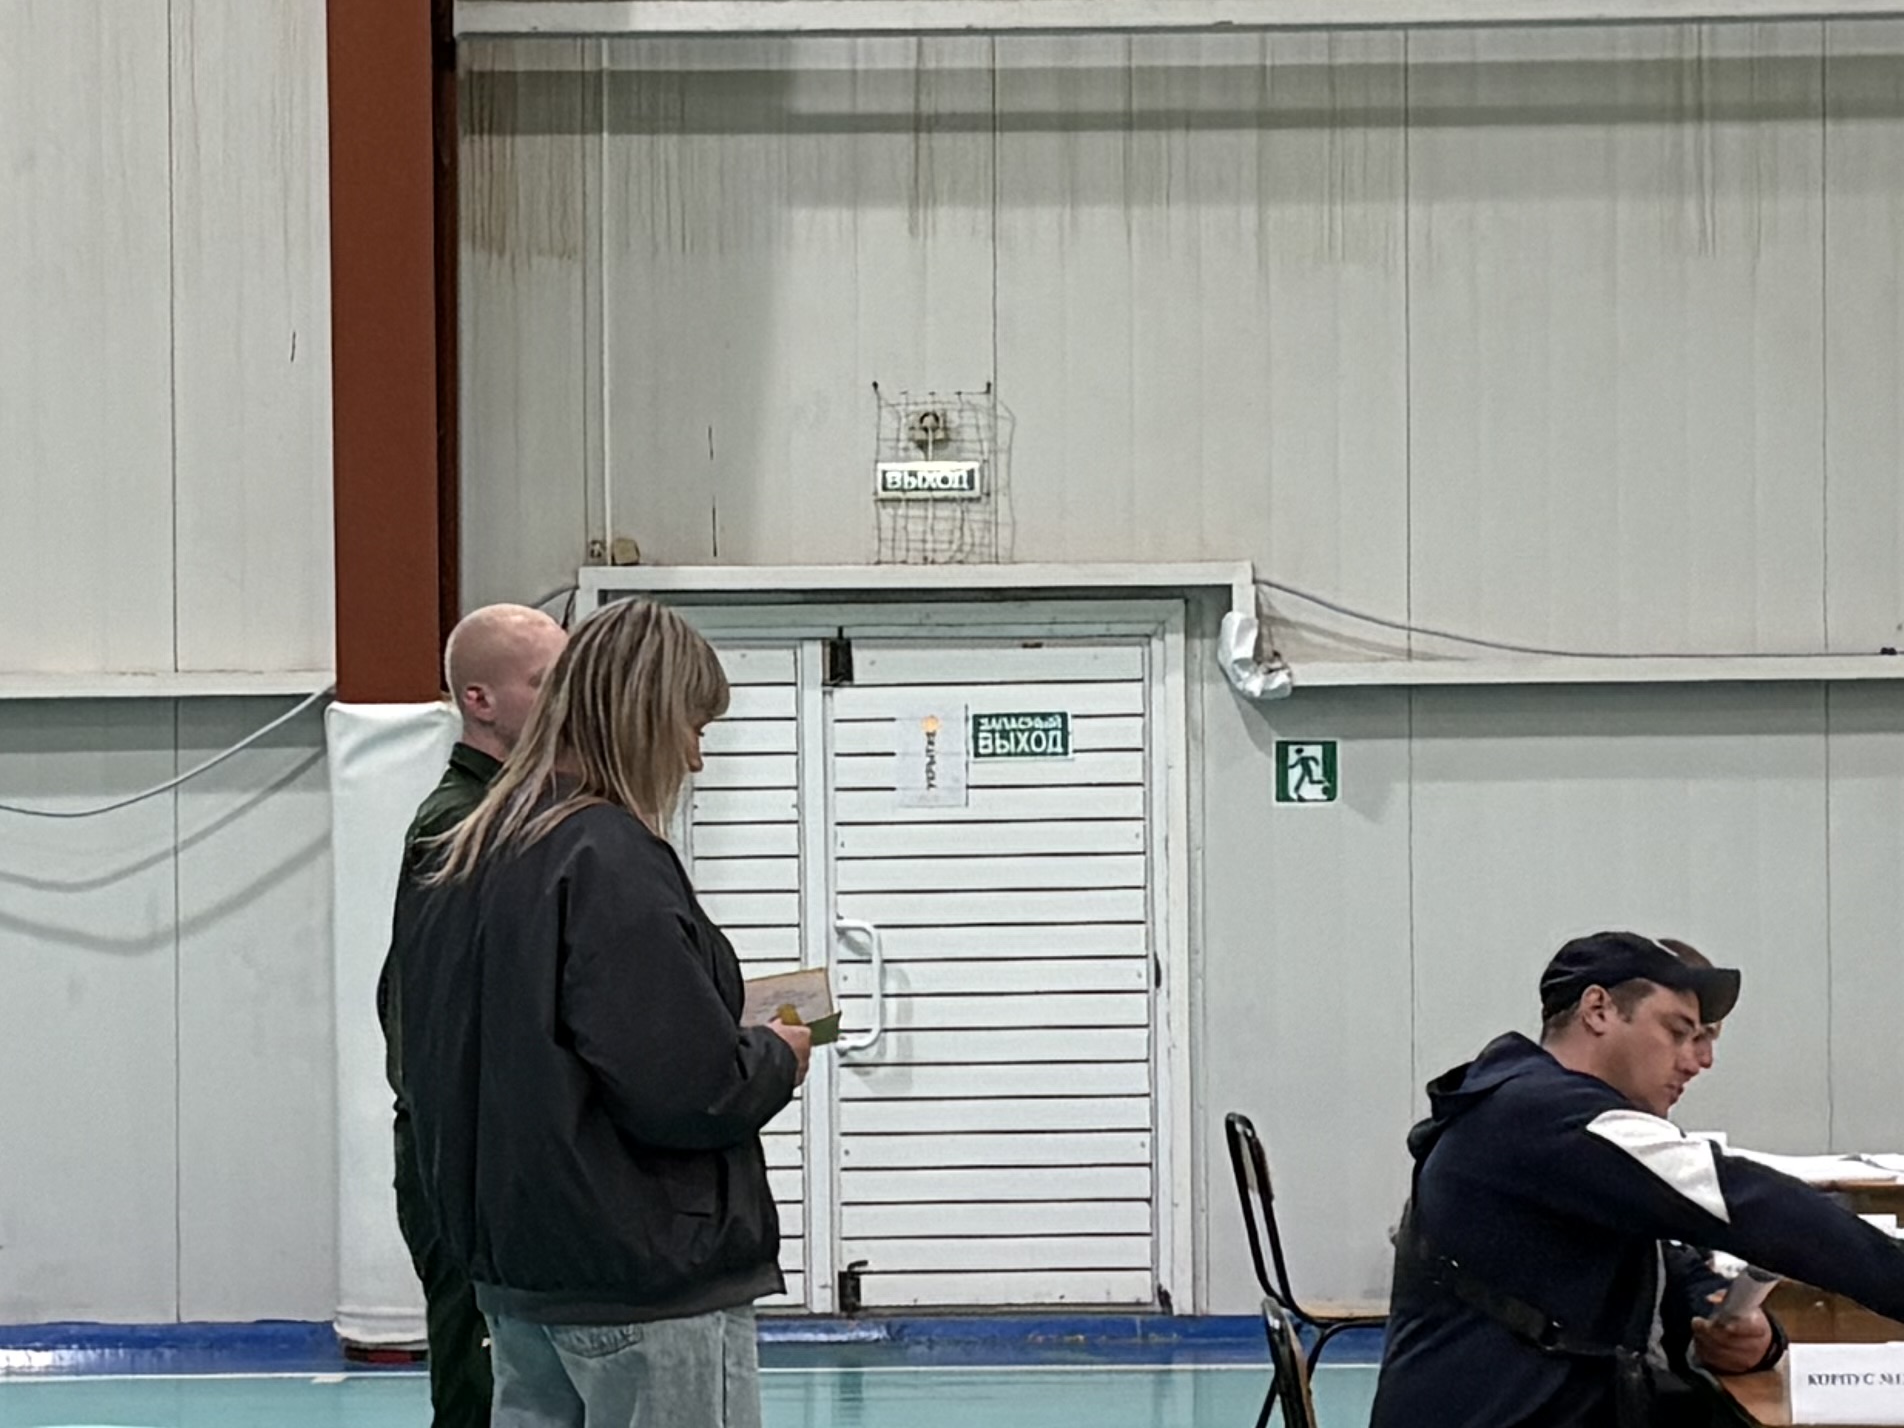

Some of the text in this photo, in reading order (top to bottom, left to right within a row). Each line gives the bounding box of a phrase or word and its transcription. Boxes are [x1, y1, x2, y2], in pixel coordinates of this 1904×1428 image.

[885, 470, 969, 490] ВЫХОД
[978, 730, 1064, 755] ВЫХОД
[1807, 1372, 1875, 1387] КОРПУС
